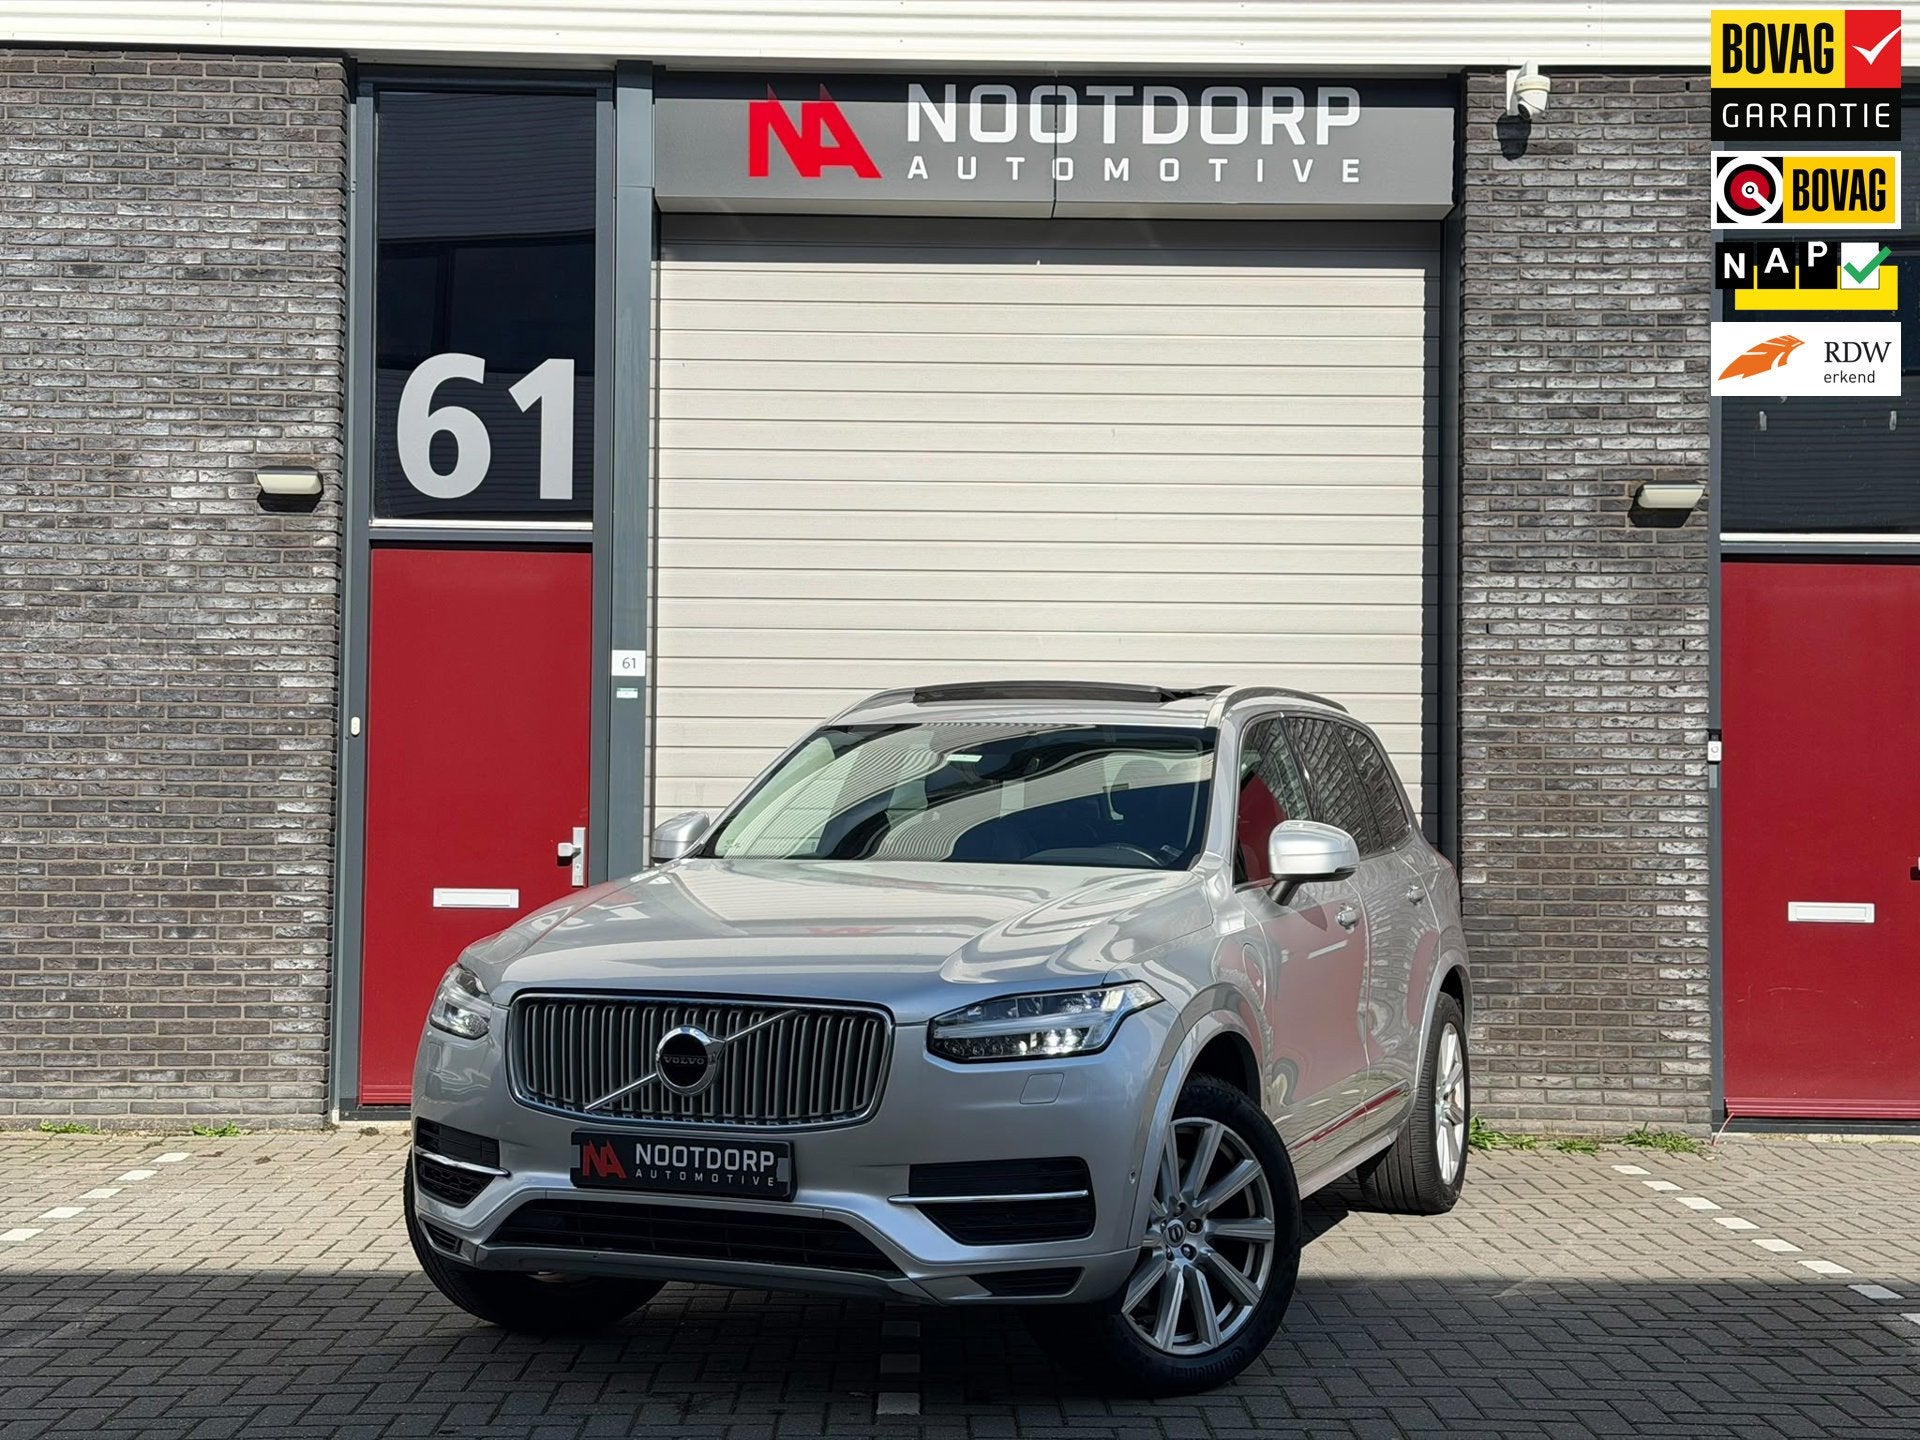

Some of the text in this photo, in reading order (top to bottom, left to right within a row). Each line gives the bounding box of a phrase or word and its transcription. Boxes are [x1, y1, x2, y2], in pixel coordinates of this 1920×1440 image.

[907, 83, 1361, 145] NOOTDORP
[748, 83, 883, 179] NA
[908, 156, 1361, 183] AUTOMOTIVE
[397, 352, 575, 500] 61
[622, 656, 636, 670] 61
[663, 1056, 705, 1065] VOLVO
[635, 1143, 775, 1173] NOOTDORP
[635, 1168, 775, 1187] AUTOMOTIVE
